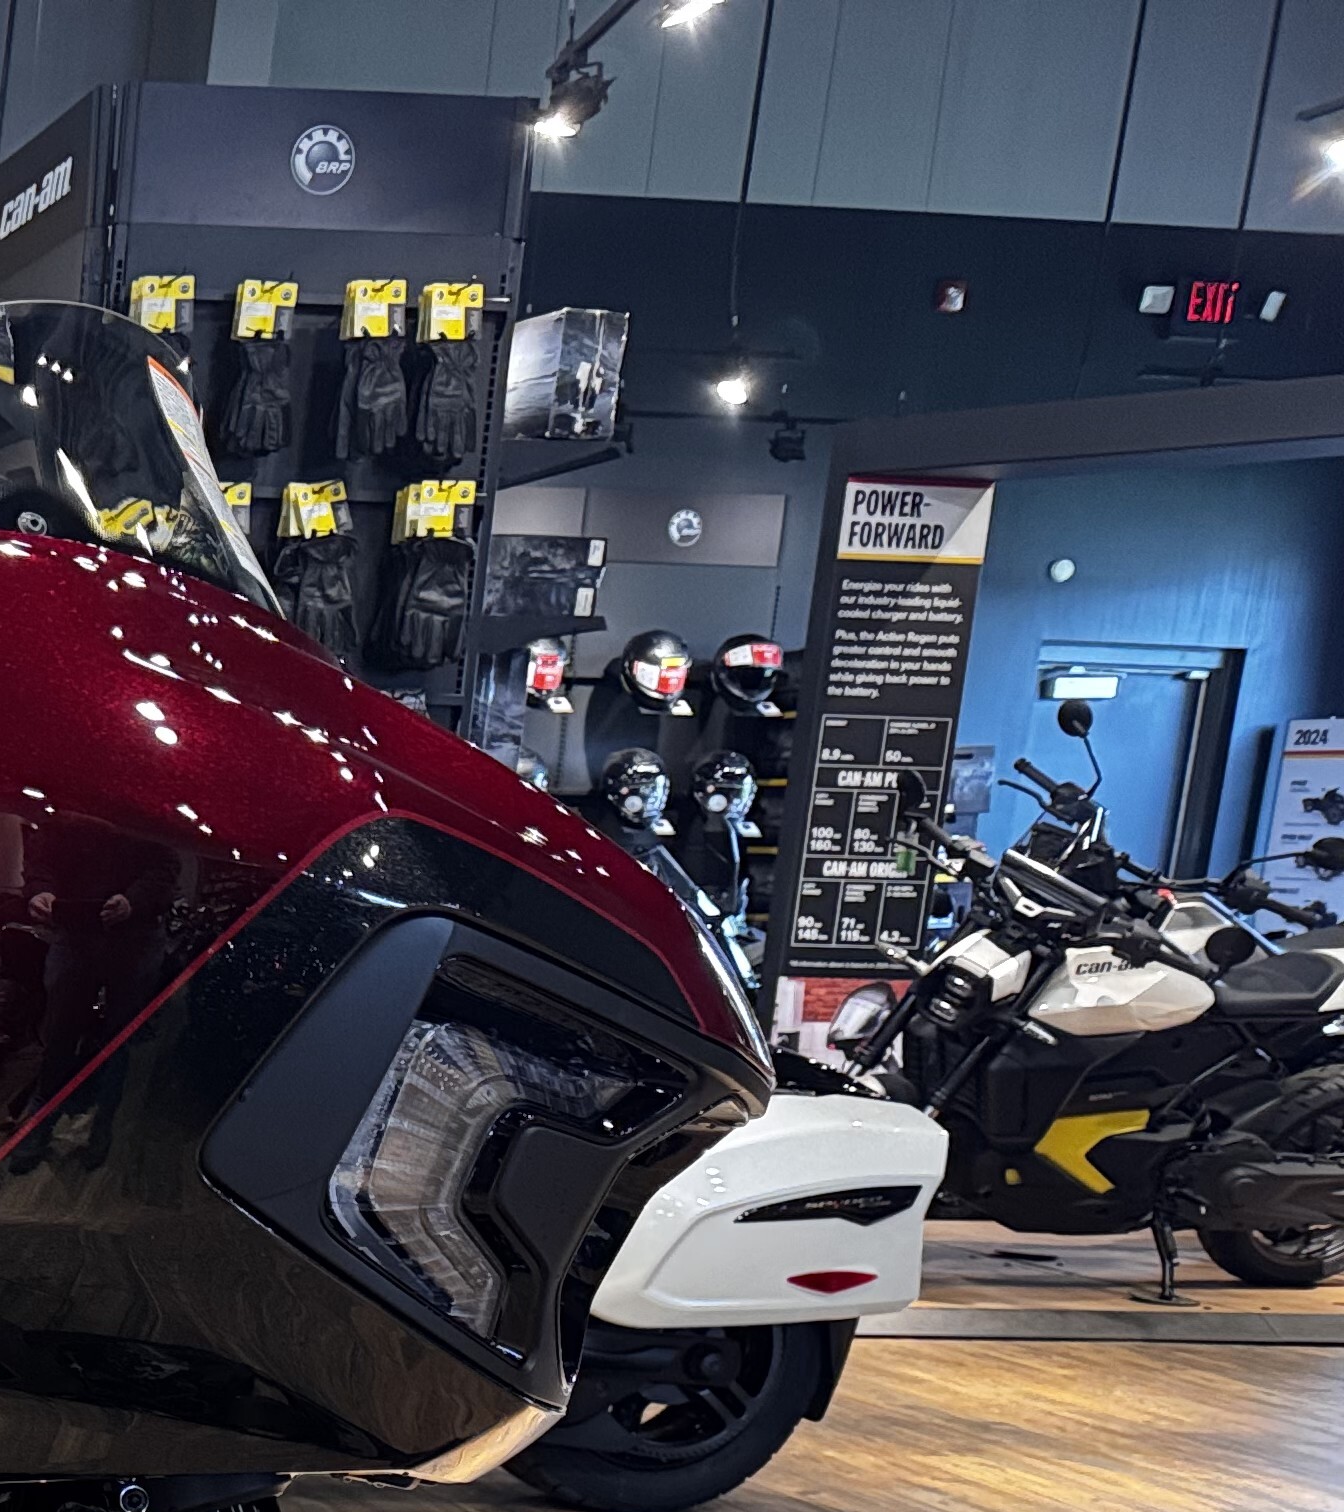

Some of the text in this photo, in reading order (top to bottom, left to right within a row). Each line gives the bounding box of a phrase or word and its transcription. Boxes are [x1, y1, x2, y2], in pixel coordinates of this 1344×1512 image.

[315, 161, 351, 174] BRP
[0, 156, 73, 240] can-am
[852, 489, 932, 518] POWER-
[848, 521, 945, 549] FORWARD
[1293, 729, 1329, 745] 2024
[837, 770, 883, 787] CAN-AM
[823, 860, 908, 878] CAN-AM ORIG
[1075, 959, 1132, 976] can-a
